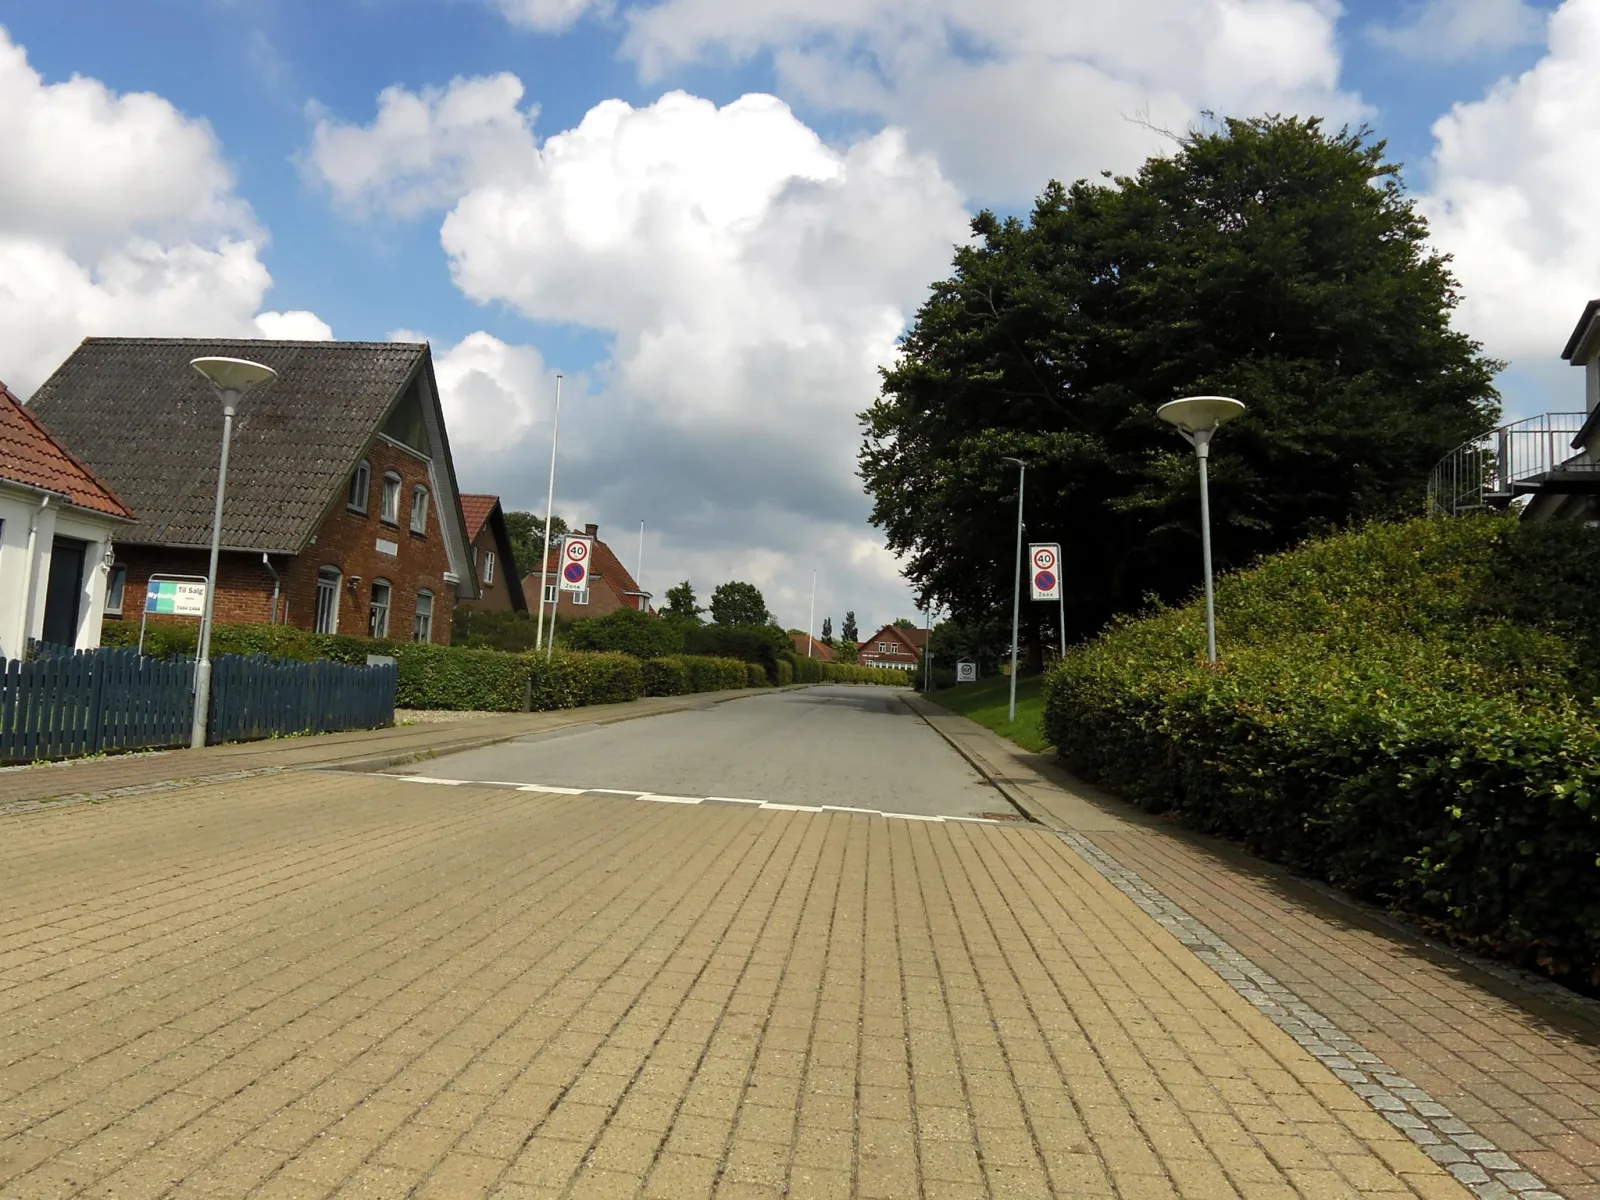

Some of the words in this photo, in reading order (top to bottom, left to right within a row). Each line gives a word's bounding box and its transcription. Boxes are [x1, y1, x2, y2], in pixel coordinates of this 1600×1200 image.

[570, 546, 584, 555] 40
[1037, 554, 1051, 563] 40
[188, 587, 204, 596] Salg
